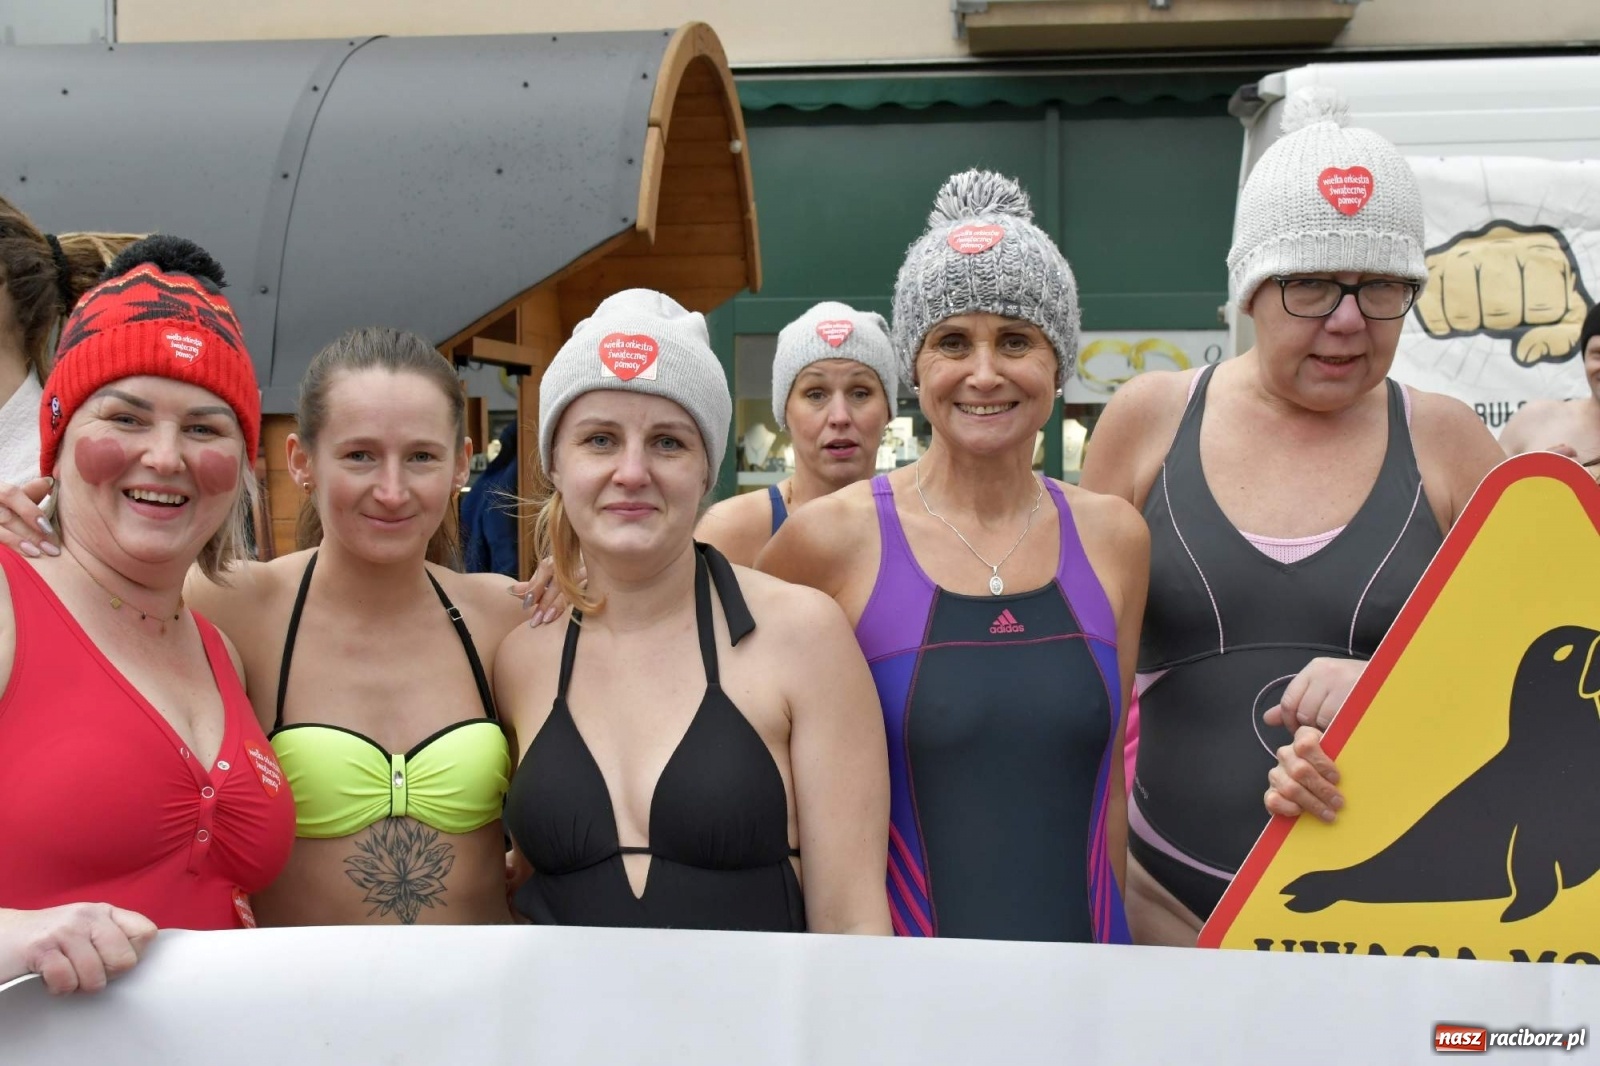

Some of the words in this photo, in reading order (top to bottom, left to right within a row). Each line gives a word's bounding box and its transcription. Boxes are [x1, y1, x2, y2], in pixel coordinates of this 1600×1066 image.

[1322, 174, 1343, 185] wielka
[1343, 174, 1370, 185] orkiestra
[1329, 184, 1367, 199] świątecznej
[1337, 197, 1362, 208] pomocy
[603, 339, 625, 349] wielka
[625, 340, 653, 351] orkiestra
[175, 350, 194, 362] pomocy
[608, 349, 648, 365] świątecznej
[614, 360, 640, 373] pomocy
[989, 624, 1025, 634] adidas
